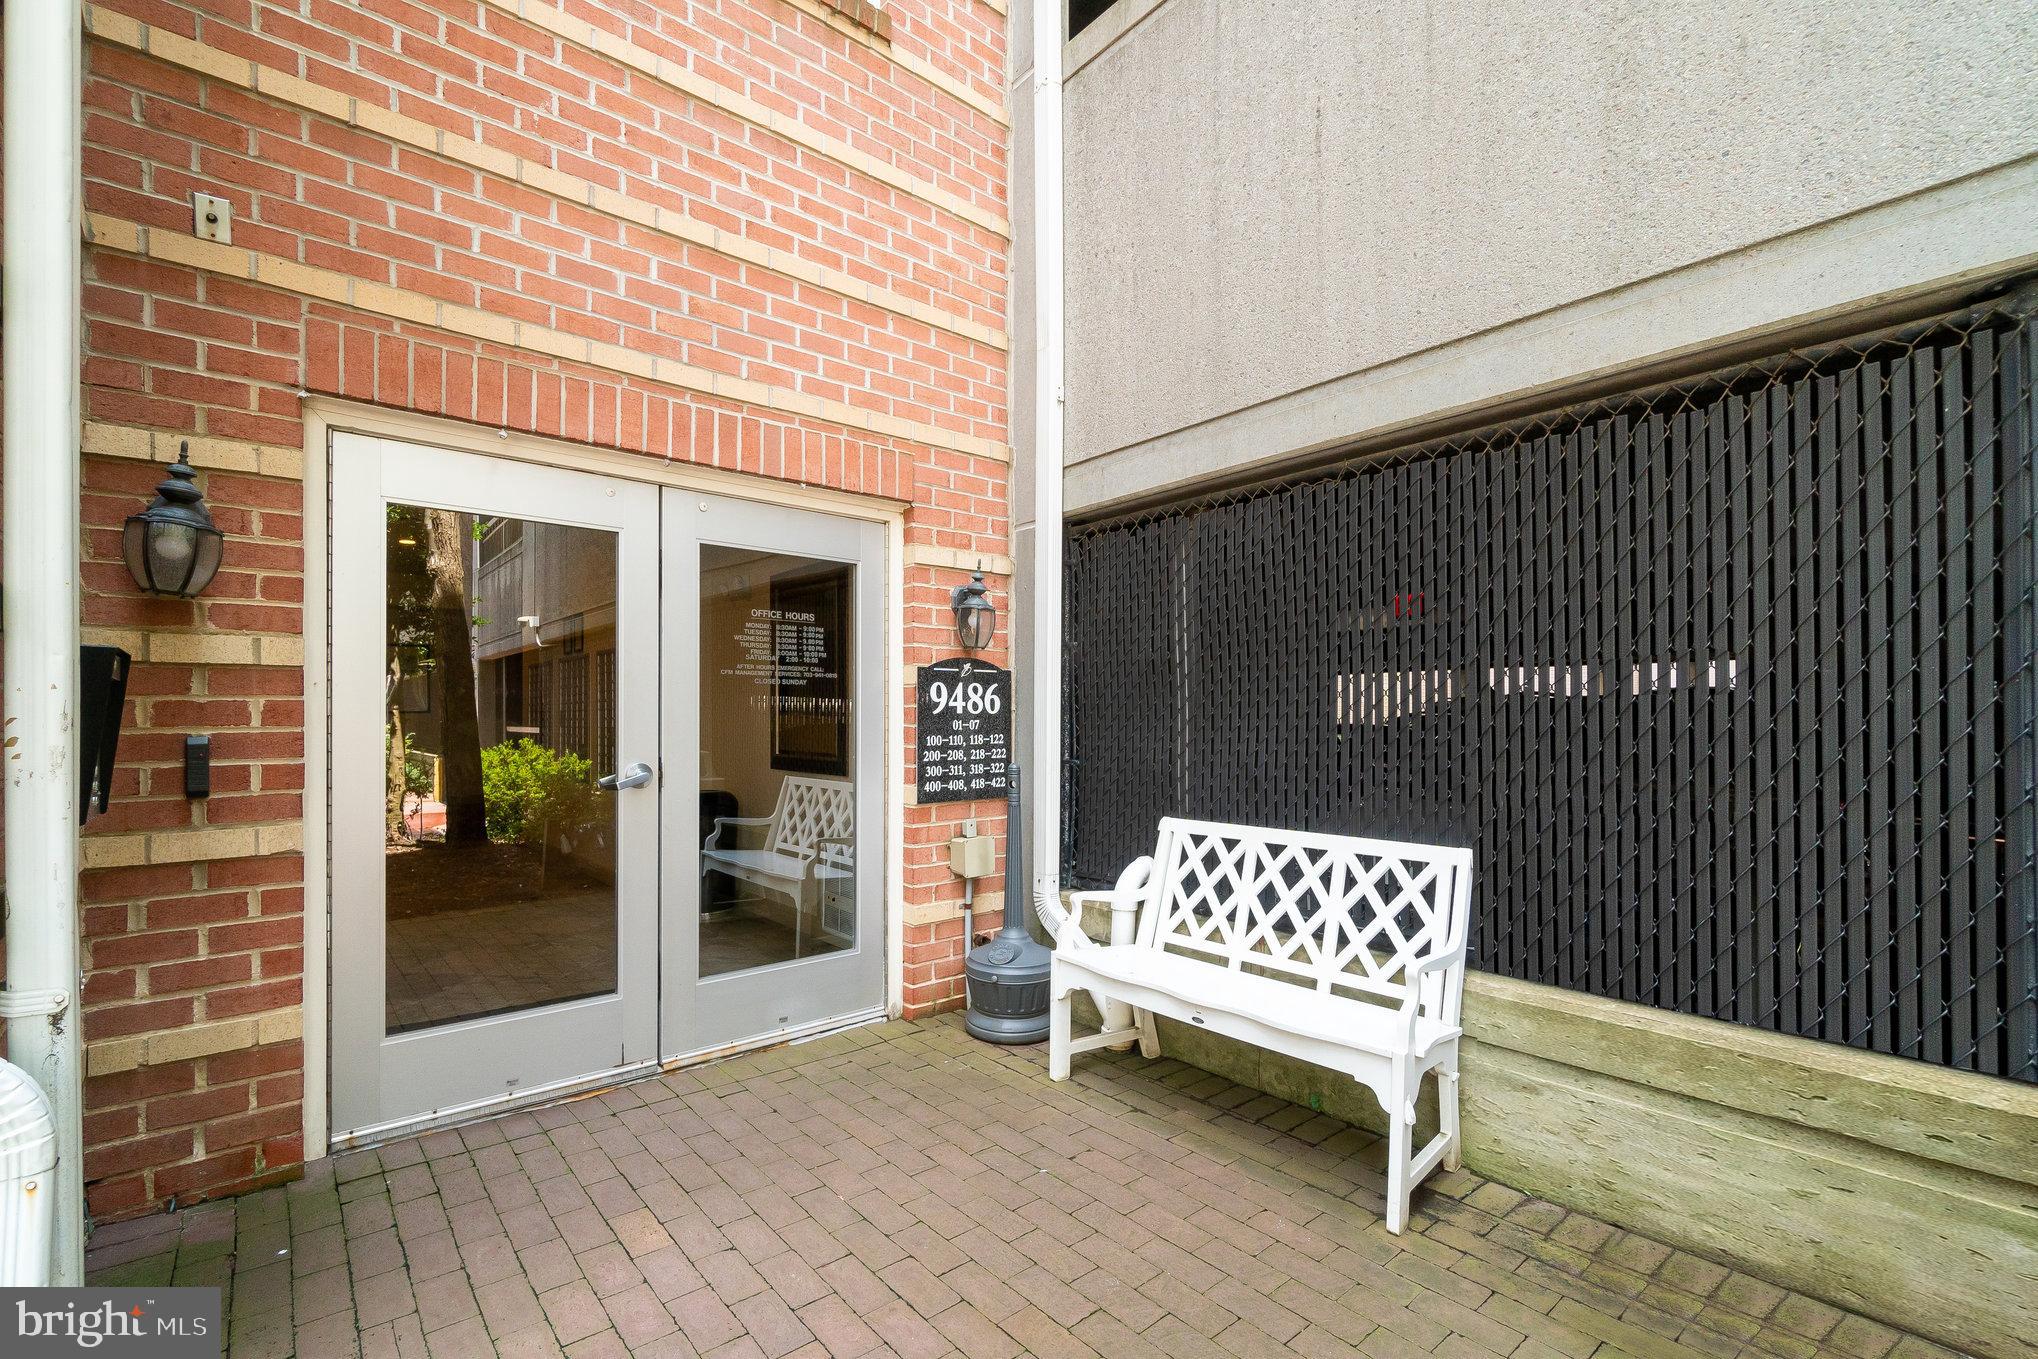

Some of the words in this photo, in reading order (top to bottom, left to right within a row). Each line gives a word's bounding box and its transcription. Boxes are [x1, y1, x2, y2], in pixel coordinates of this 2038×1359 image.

[751, 608, 783, 619] OFFICE
[785, 611, 816, 622] HOURS
[782, 678, 808, 686] SUNDAY
[929, 681, 1001, 715] 9486
[952, 719, 980, 731] 01-07
[925, 734, 967, 747] 100-110,
[969, 733, 1005, 745] 118-122
[923, 749, 967, 762] 200-208,
[970, 748, 1007, 760] 218-222
[925, 764, 966, 777] 300-311,
[969, 762, 1005, 775] 318-322
[923, 779, 968, 792] 400-408,
[970, 777, 1006, 790] 418-422
